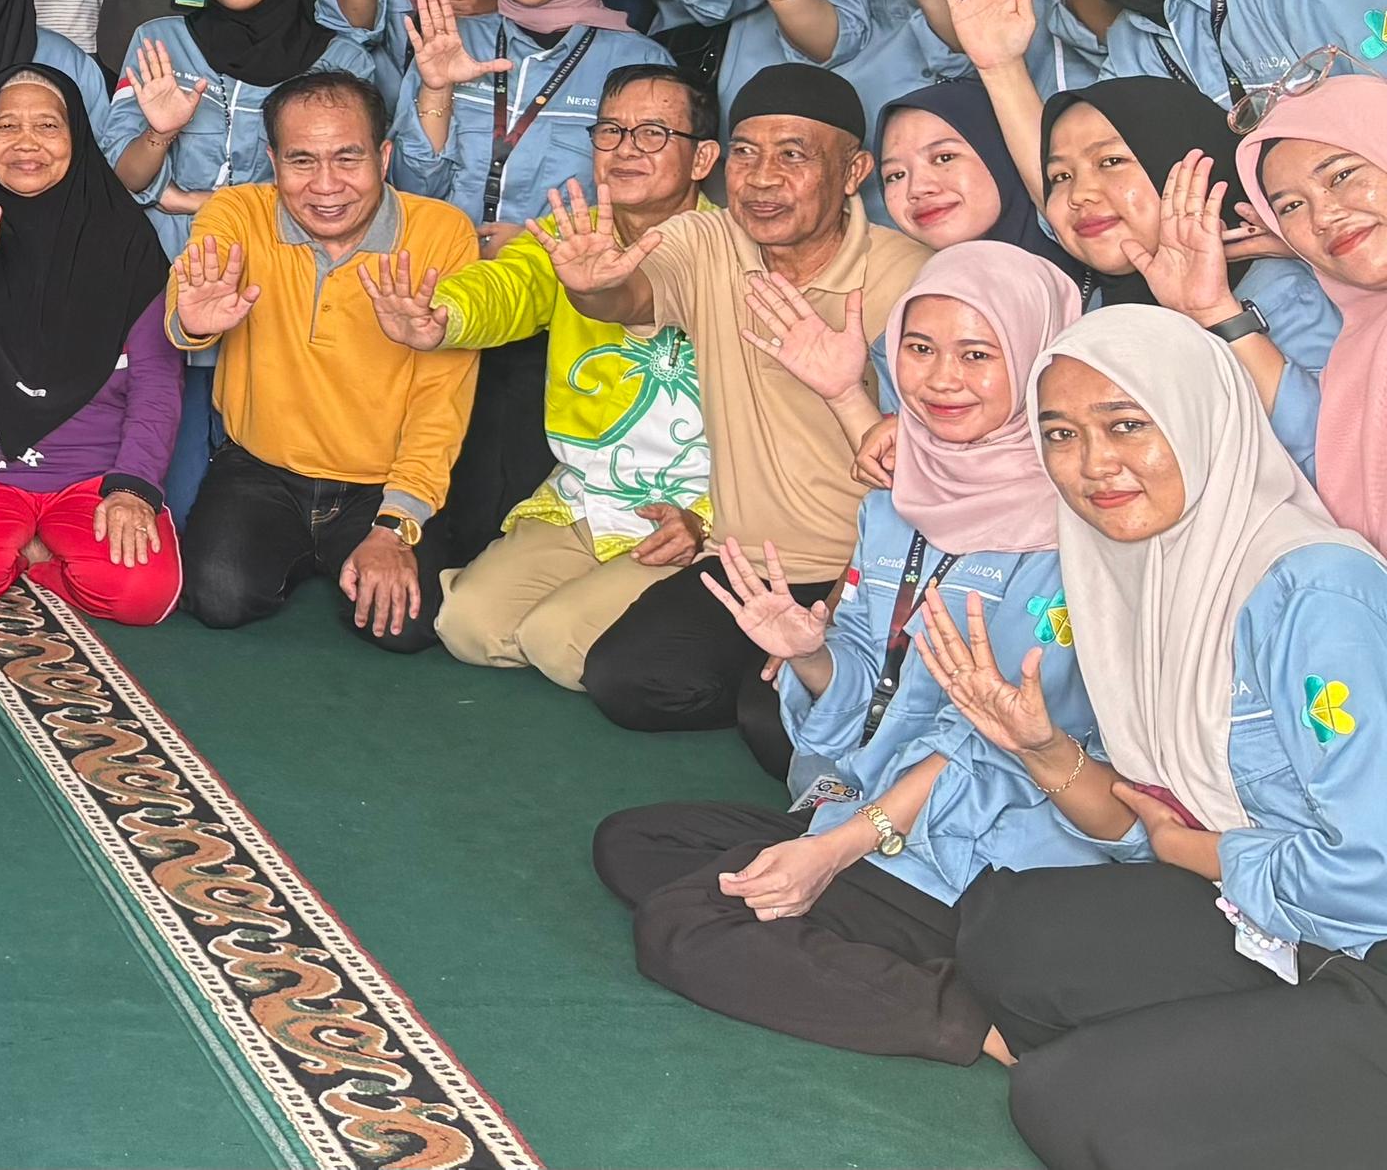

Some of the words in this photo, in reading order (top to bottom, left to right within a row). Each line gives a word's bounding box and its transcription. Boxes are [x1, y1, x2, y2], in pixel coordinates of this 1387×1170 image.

[565, 95, 598, 107] NERS
[965, 563, 1003, 583] MUDA
[1229, 680, 1252, 696] DA
